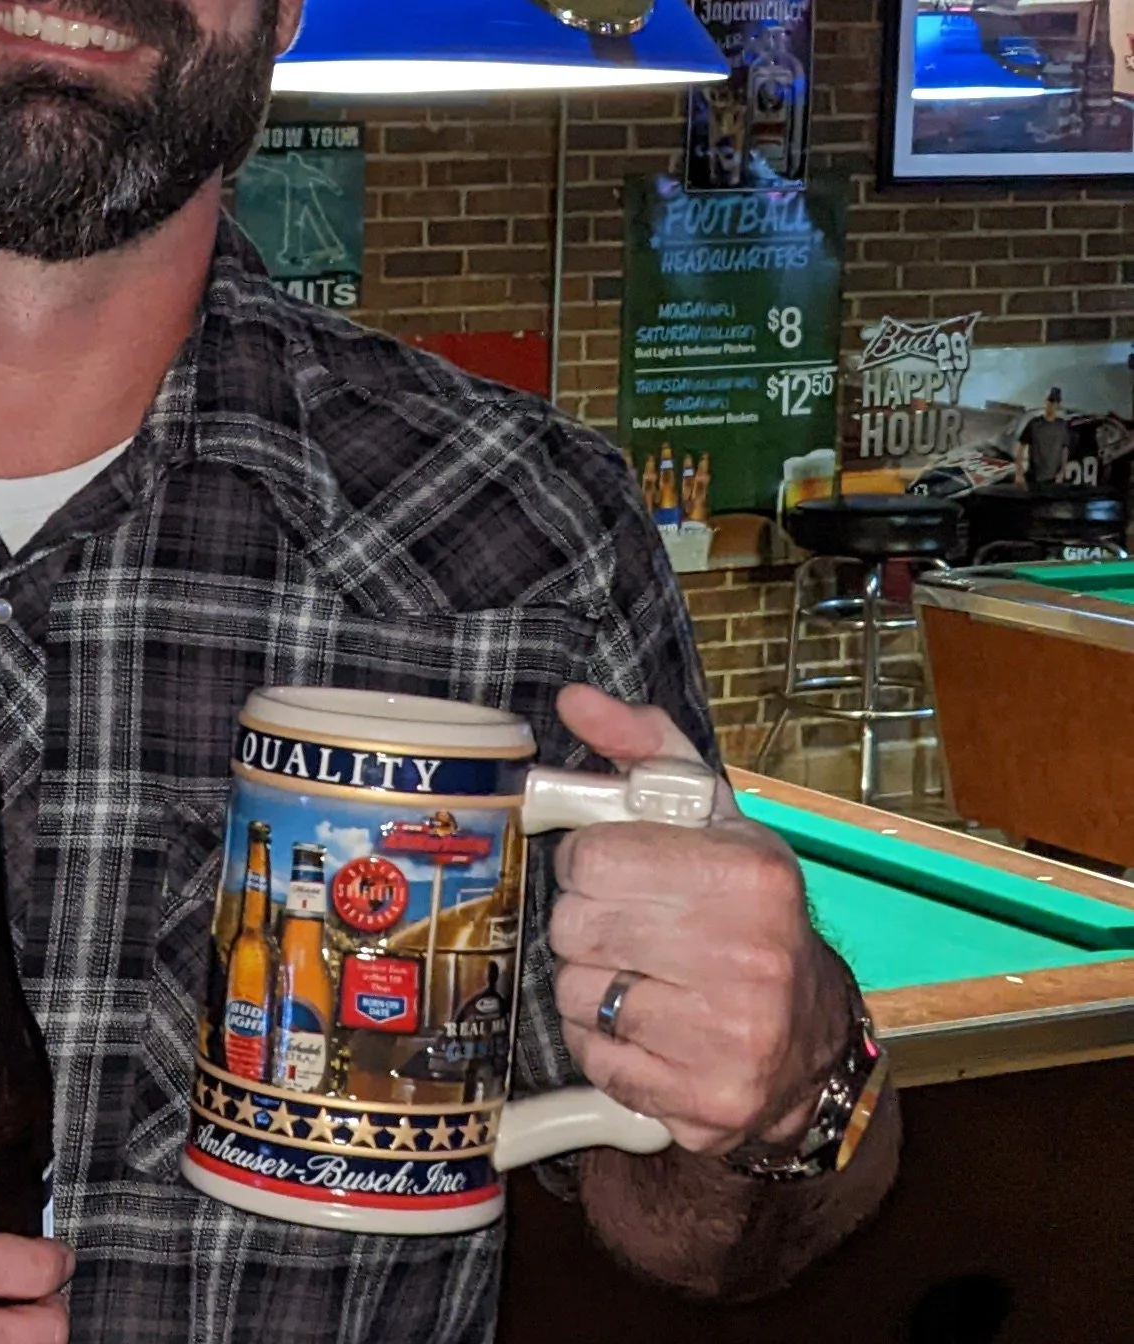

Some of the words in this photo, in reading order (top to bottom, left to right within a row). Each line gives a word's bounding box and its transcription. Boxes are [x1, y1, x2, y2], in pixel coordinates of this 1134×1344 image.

[260, 125, 304, 149] NOW
[309, 126, 360, 148] YOUR
[665, 193, 812, 236] FOOTBALL
[661, 245, 810, 274] HEADQUARTERS
[273, 278, 357, 307] MITS
[767, 306, 803, 349] $8
[634, 346, 652, 359] Bud
[653, 346, 674, 360] Light
[872, 323, 939, 357] Bud
[935, 331, 970, 372] 29
[862, 370, 966, 408] HAPPY
[632, 416, 651, 429] Bud
[652, 416, 674, 430] Light
[859, 408, 964, 458] HOUR
[241, 731, 443, 793] QUALITY
[230, 1002, 263, 1019] BUD
[444, 1020, 485, 1037] REAL
